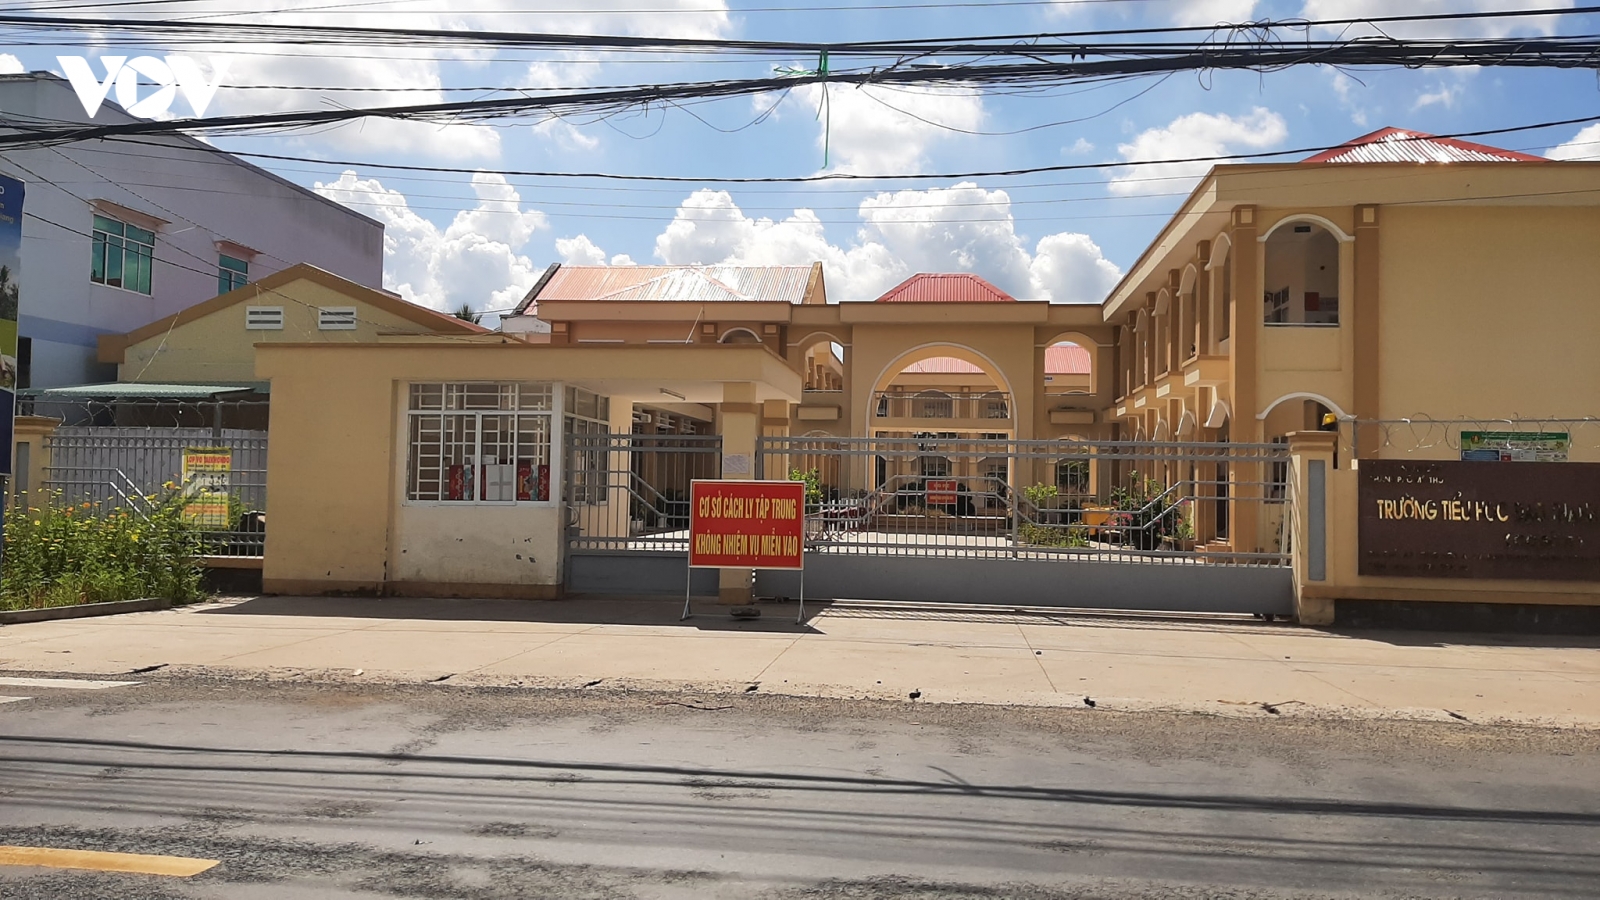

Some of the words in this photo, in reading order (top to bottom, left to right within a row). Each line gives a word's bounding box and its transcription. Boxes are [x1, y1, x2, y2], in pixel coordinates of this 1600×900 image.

[699, 495, 710, 518] CƠ
[711, 490, 722, 518] SỞ
[723, 493, 744, 519] CÁCH
[745, 498, 754, 519] LY
[756, 494, 770, 524] TẬP
[771, 498, 797, 520] TRUNG
[1377, 493, 1438, 521] TRƯỜNG
[1441, 491, 1471, 521] TIỂU
[695, 529, 722, 555] KHÔNG
[722, 530, 748, 560] NHIỆM
[749, 535, 760, 561] VỤ
[783, 531, 798, 557] VÀO
